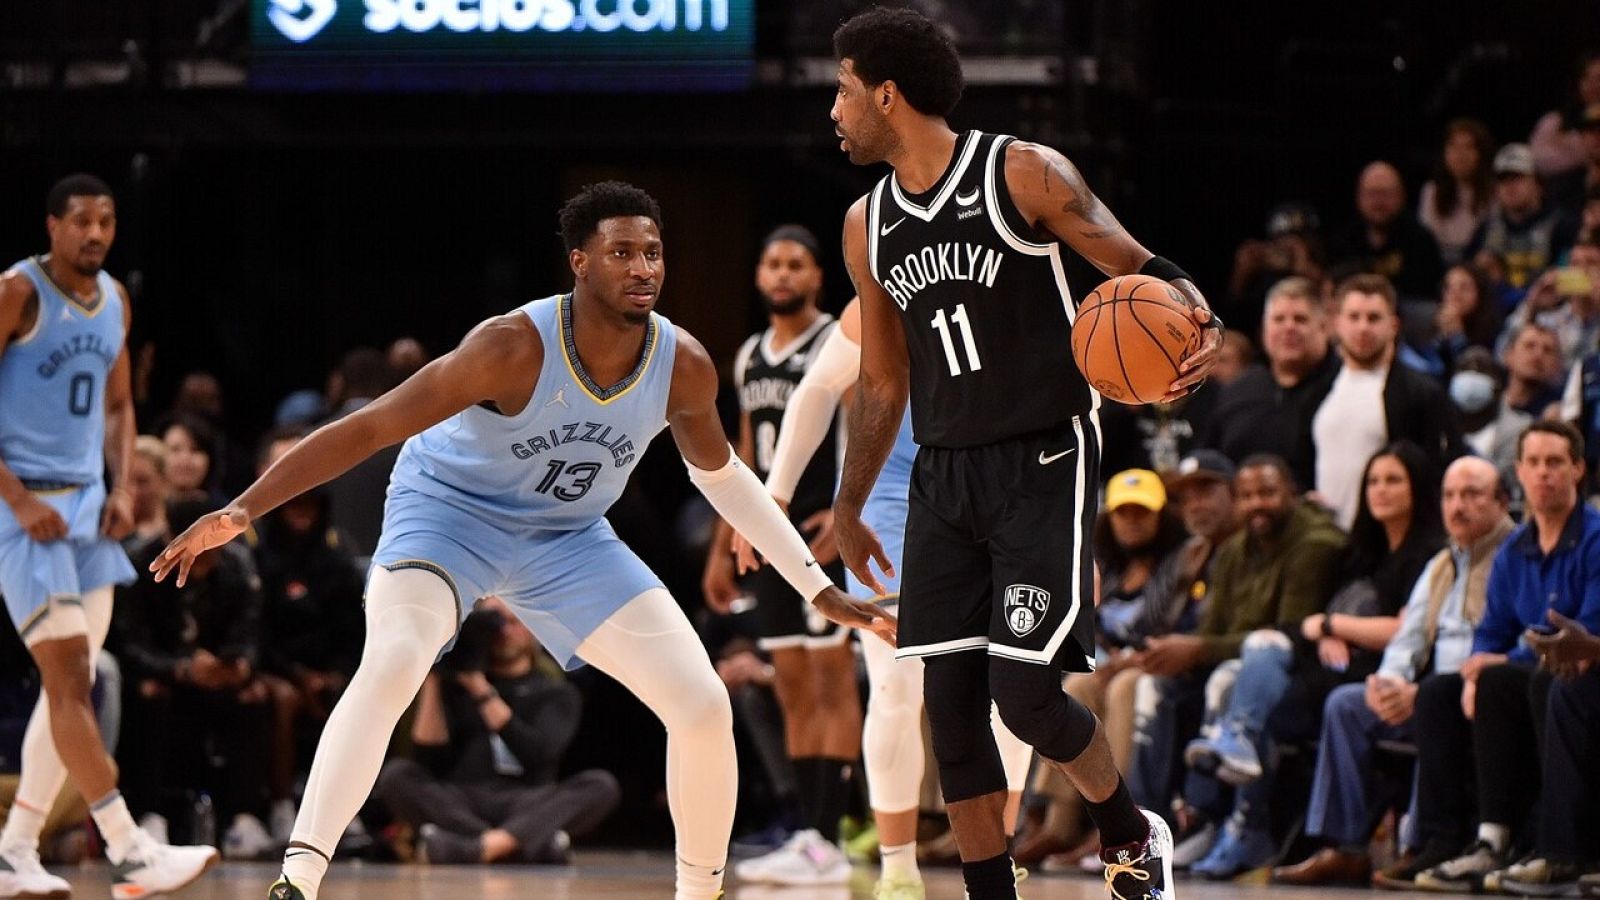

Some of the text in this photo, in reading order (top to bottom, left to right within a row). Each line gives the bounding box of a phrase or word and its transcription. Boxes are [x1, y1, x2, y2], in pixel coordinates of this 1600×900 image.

[957, 206, 982, 220] Webull
[884, 242, 1004, 312] BROOKLYN
[931, 303, 982, 377] 11
[69, 371, 94, 416] 0
[511, 421, 635, 468] GRIZZLIES
[534, 459, 603, 502] 13
[1005, 586, 1047, 611] NETS
[1017, 610, 1026, 630] B
